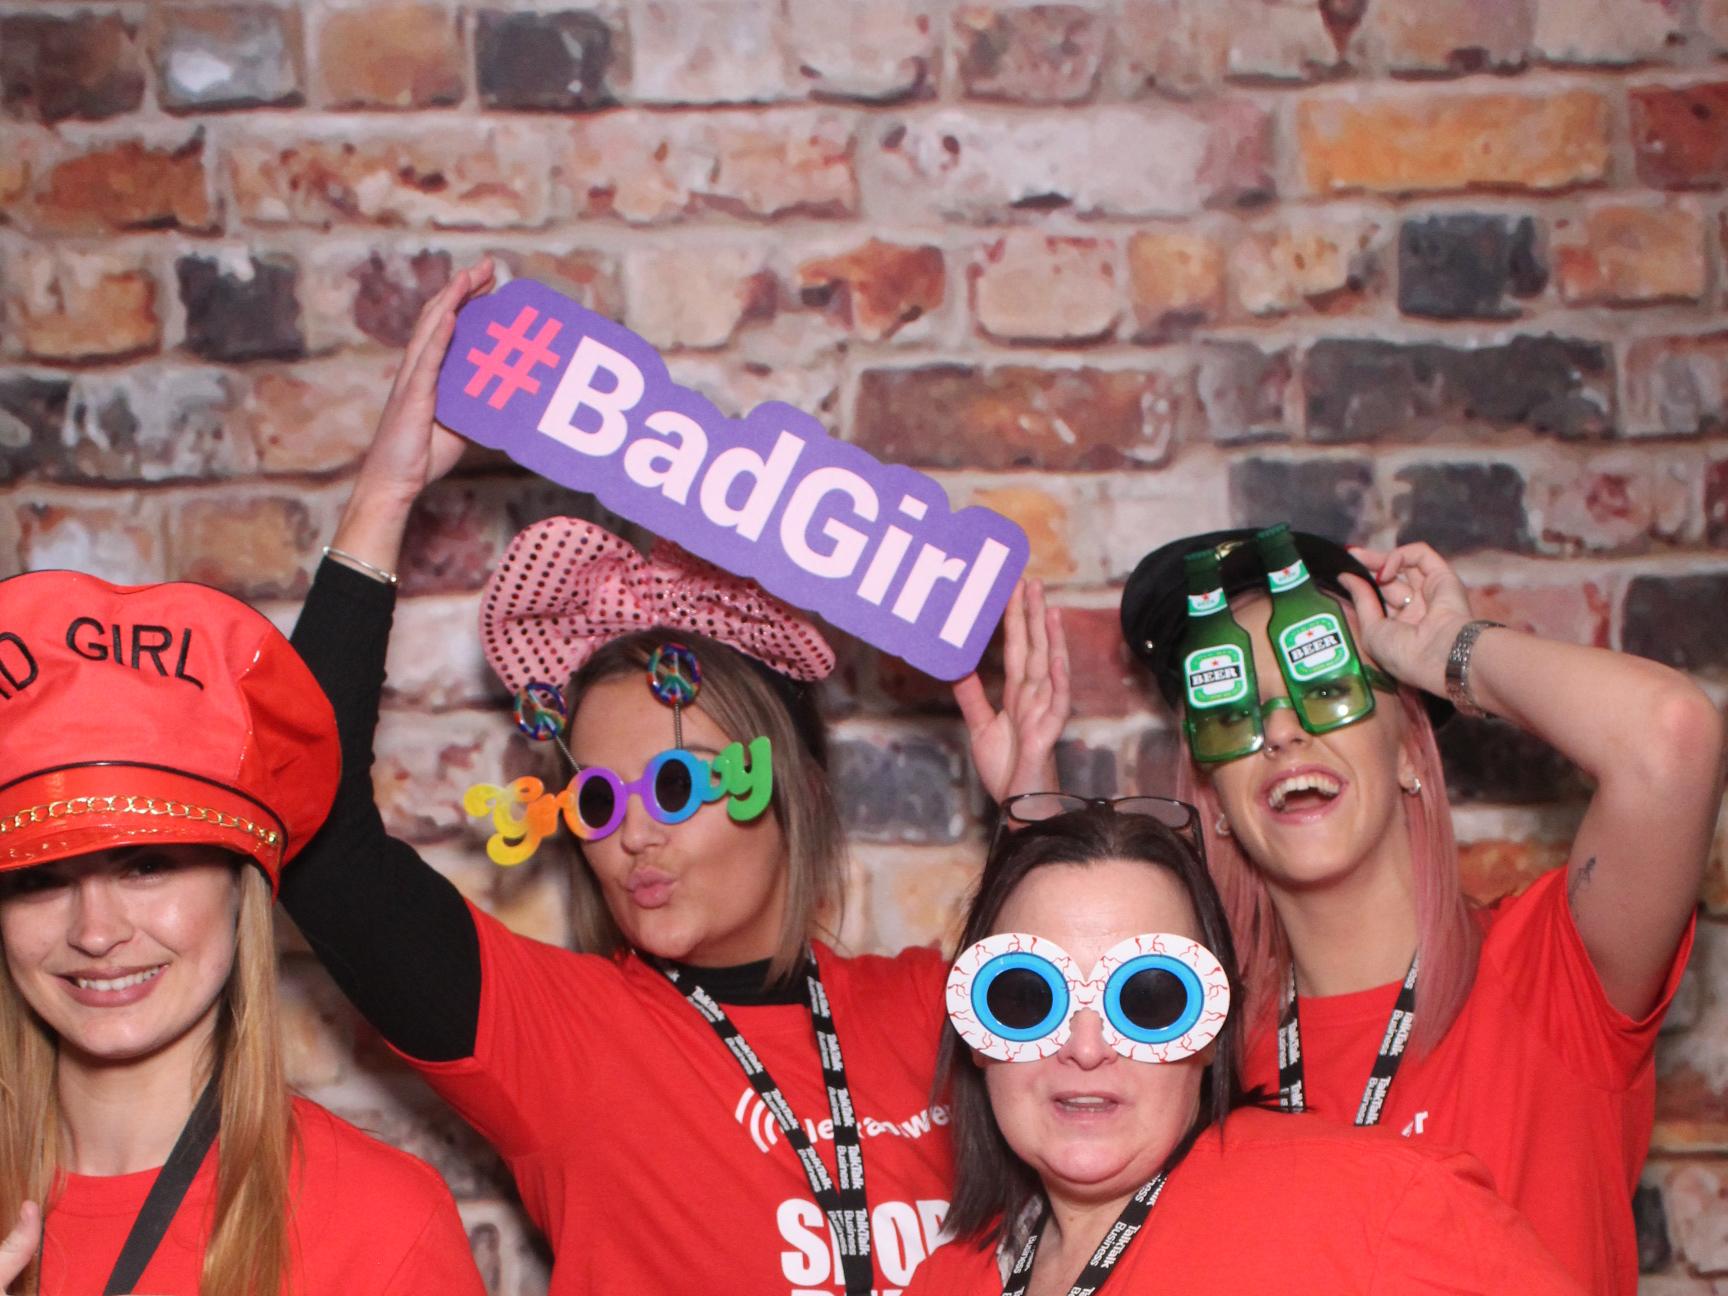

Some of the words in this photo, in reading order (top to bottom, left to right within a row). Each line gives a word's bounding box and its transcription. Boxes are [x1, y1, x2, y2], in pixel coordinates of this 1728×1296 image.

[463, 305, 1010, 648] #BadGirl
[66, 616, 204, 690] GIRL
[1291, 635, 1338, 663] BEER
[1191, 666, 1239, 687] BEER
[1389, 1012, 1414, 1057] alkTalk
[848, 1144, 864, 1189] TalkTalk
[855, 1208, 870, 1255] TalkTalk
[1090, 1221, 1127, 1266] Business
[1101, 1224, 1141, 1268] TalkTalk
